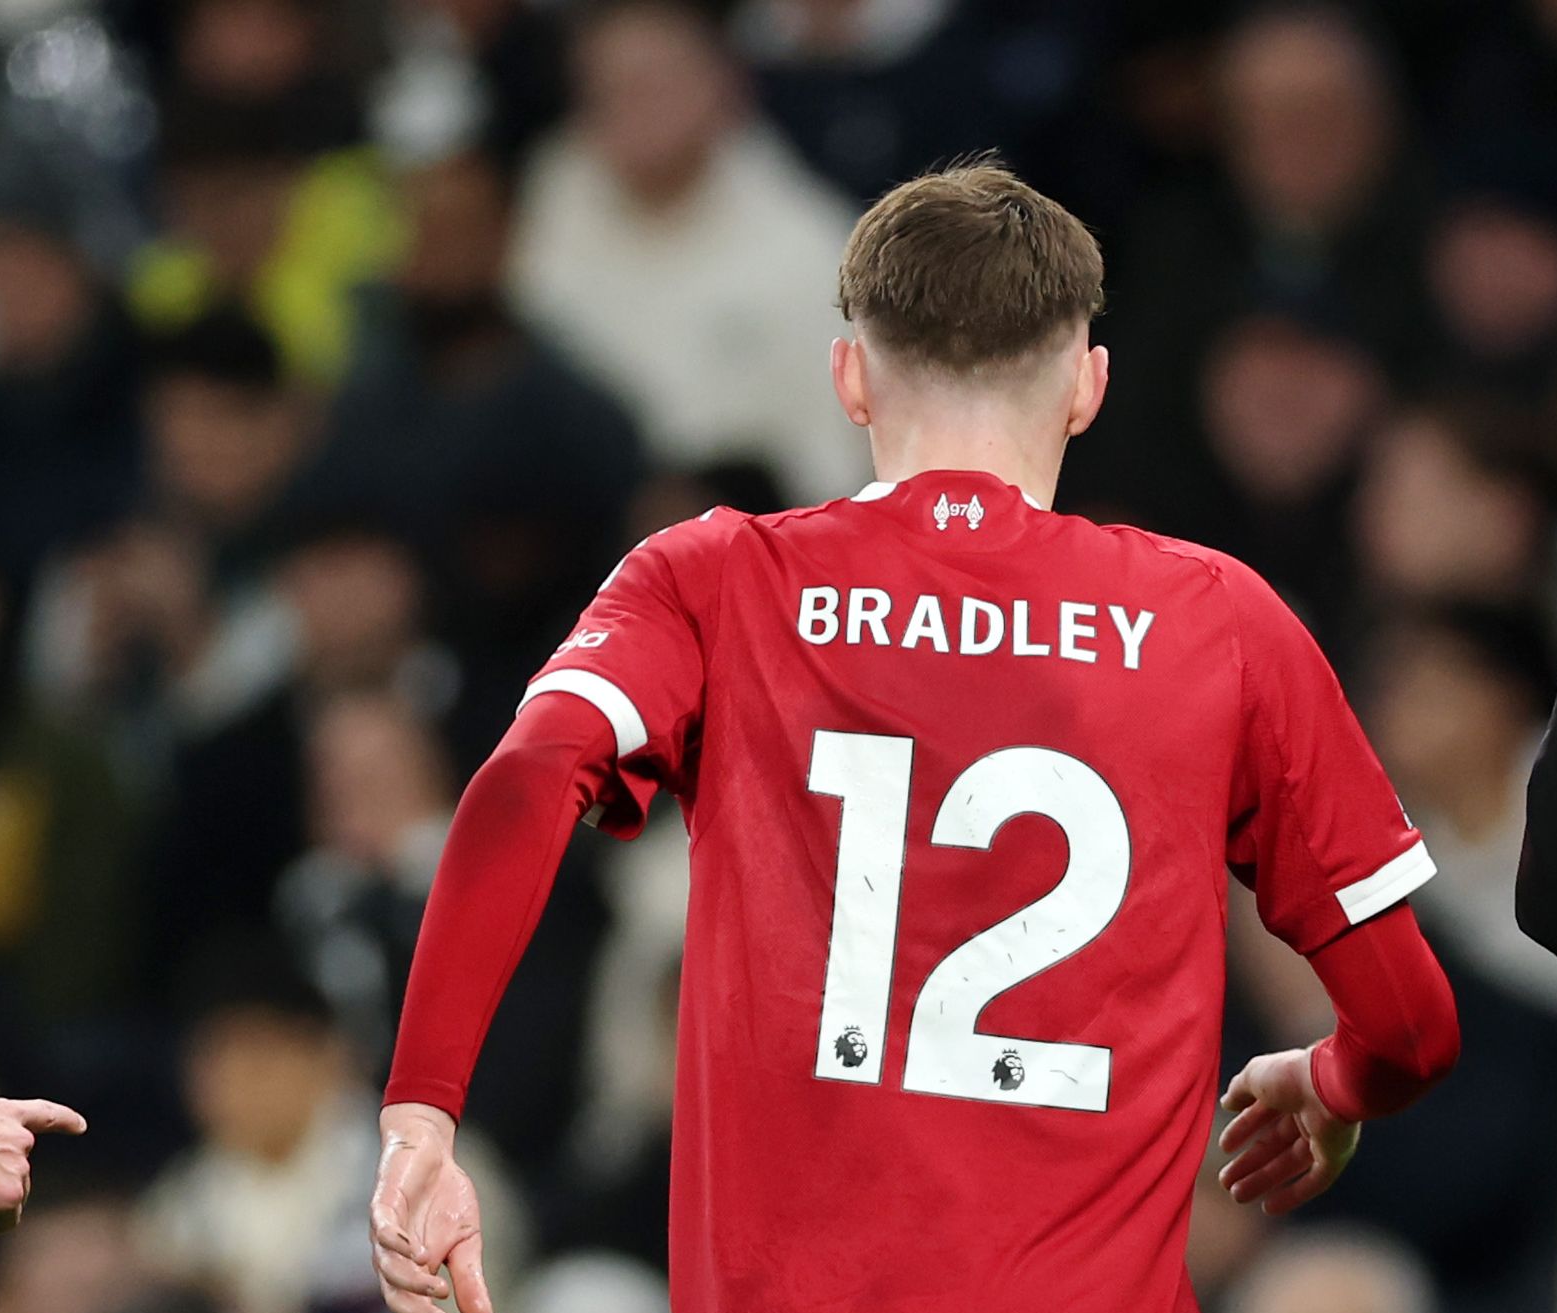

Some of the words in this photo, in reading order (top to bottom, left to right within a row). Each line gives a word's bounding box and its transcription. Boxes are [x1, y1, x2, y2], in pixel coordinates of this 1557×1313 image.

[949, 503, 969, 516] 97
[796, 585, 1156, 670] BRADLEY
[807, 728, 1133, 1113] 12
